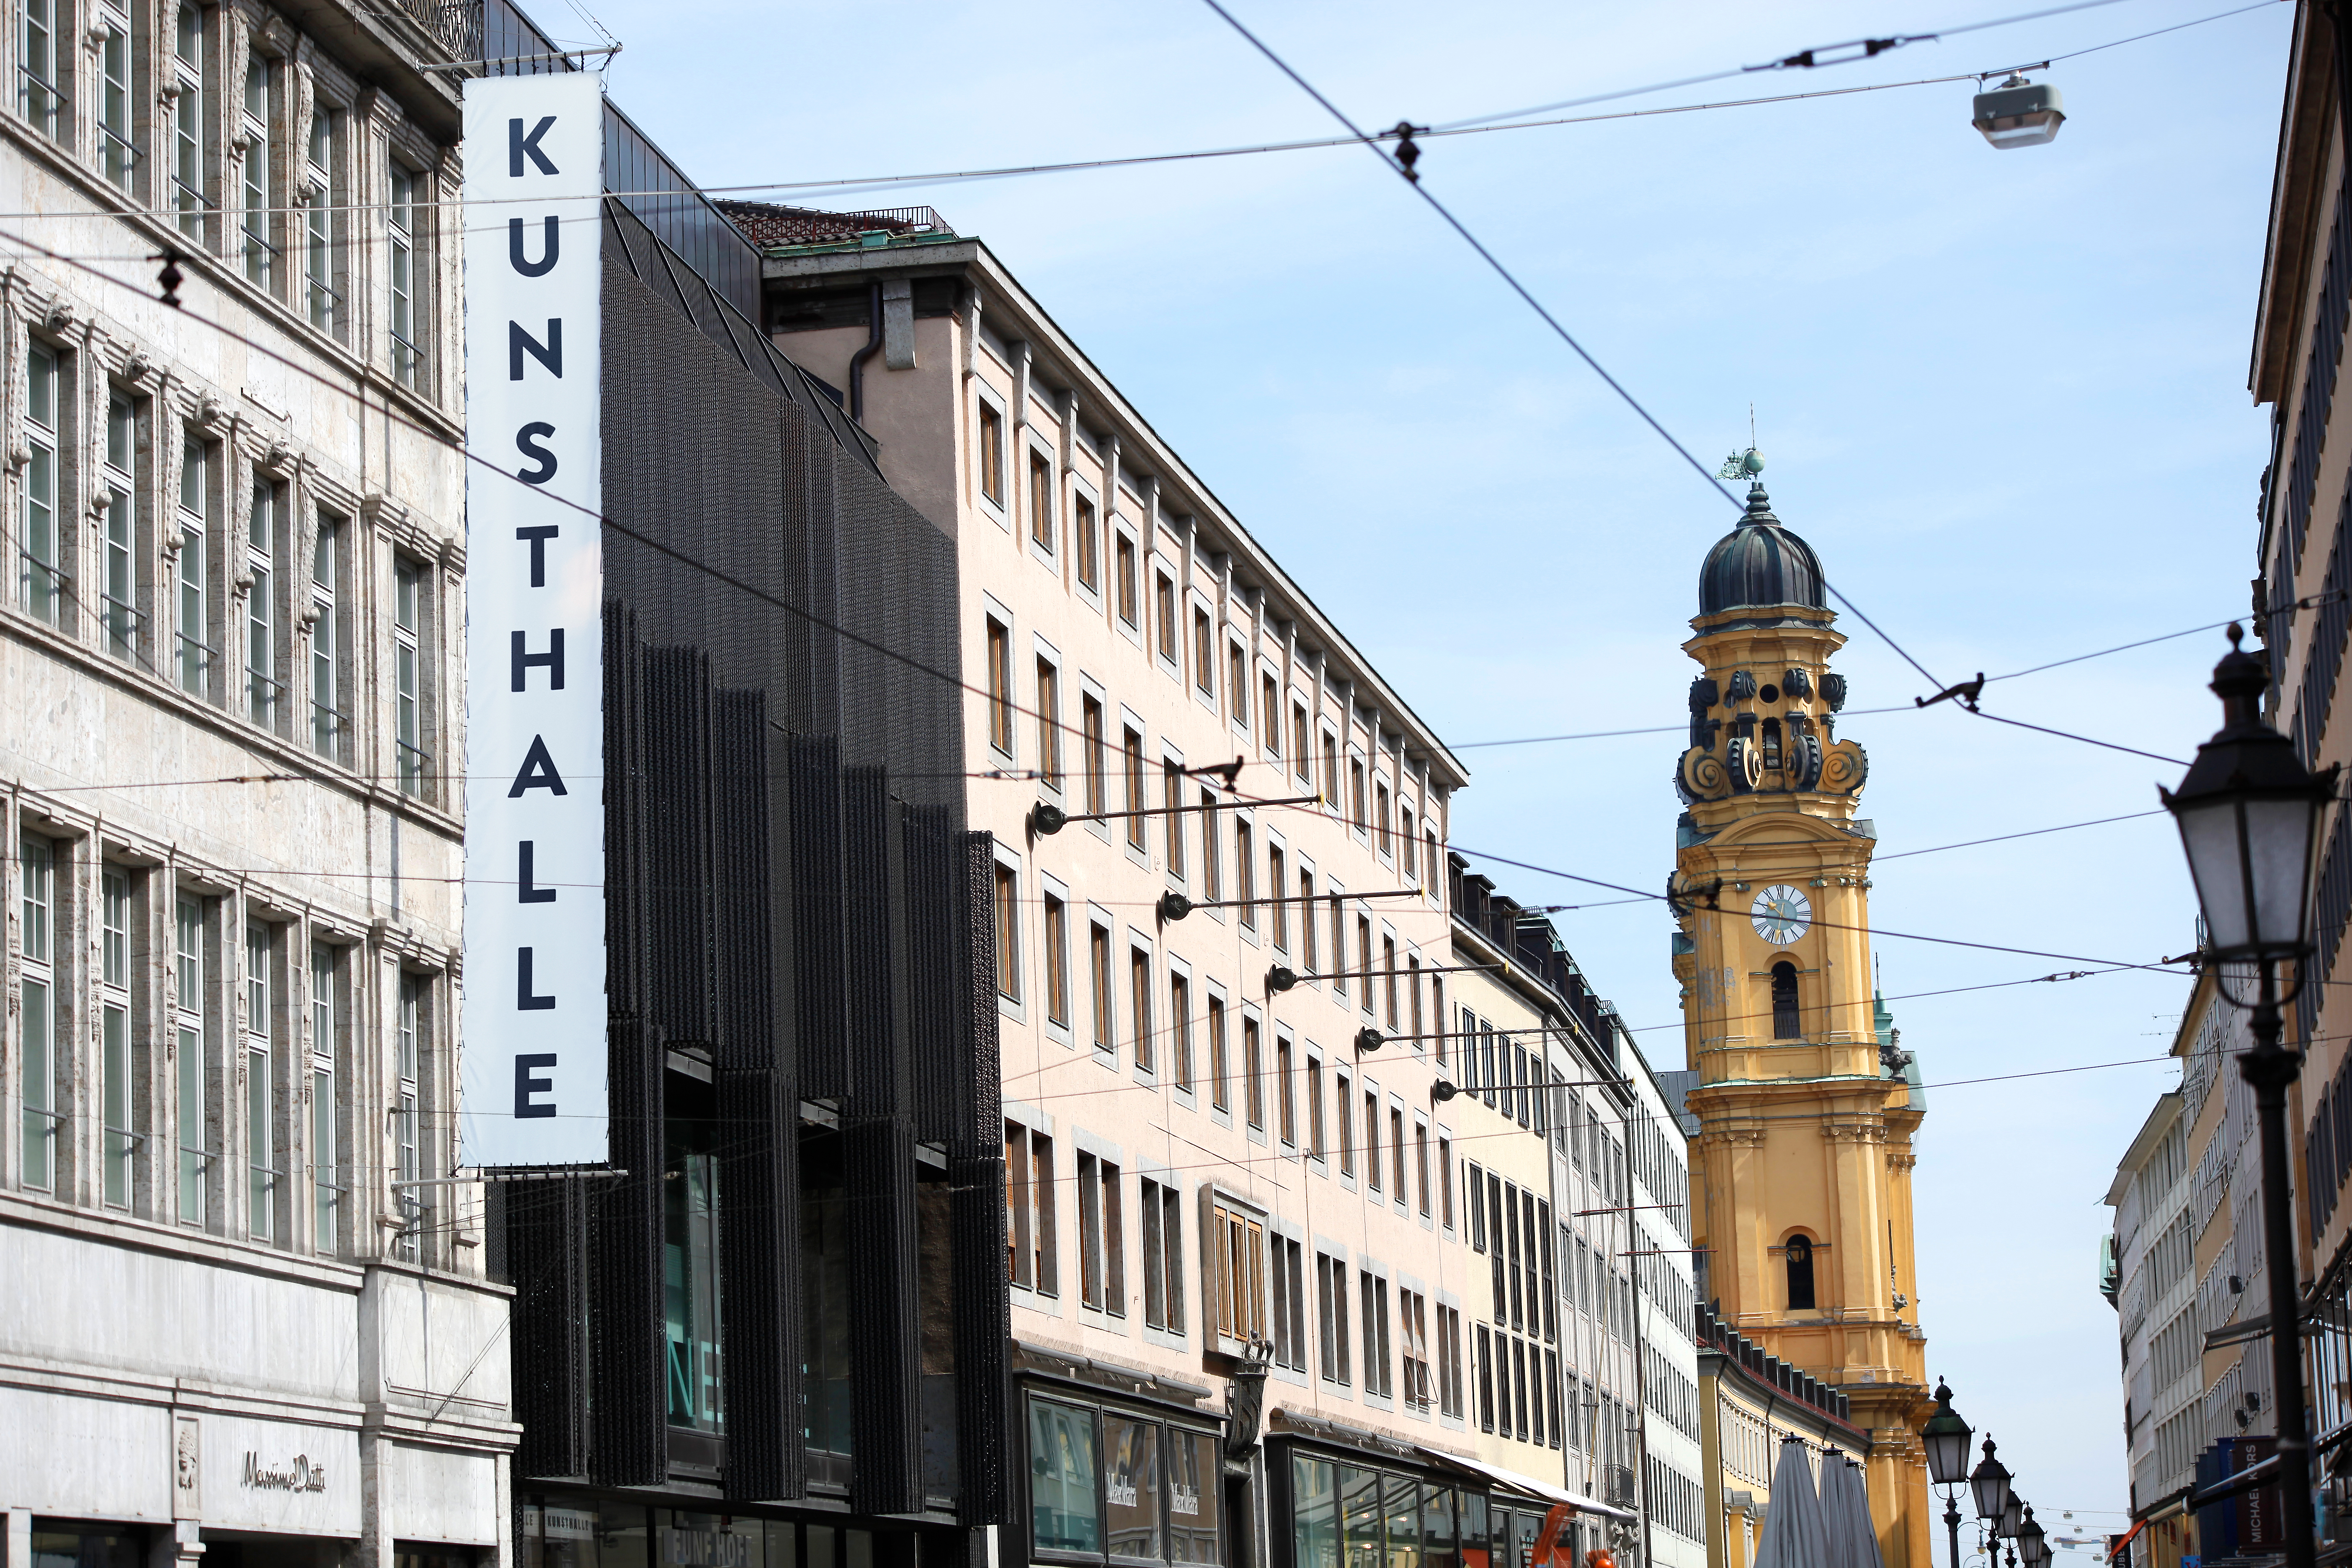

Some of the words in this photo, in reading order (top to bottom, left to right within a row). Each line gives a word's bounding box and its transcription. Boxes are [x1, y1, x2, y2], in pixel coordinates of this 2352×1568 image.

[508, 116, 568, 1119] KUNSTHALLE
[241, 1451, 296, 1491] Massimo
[294, 1454, 326, 1493] Dutti
[547, 1515, 589, 1531] KUNSTHALLE
